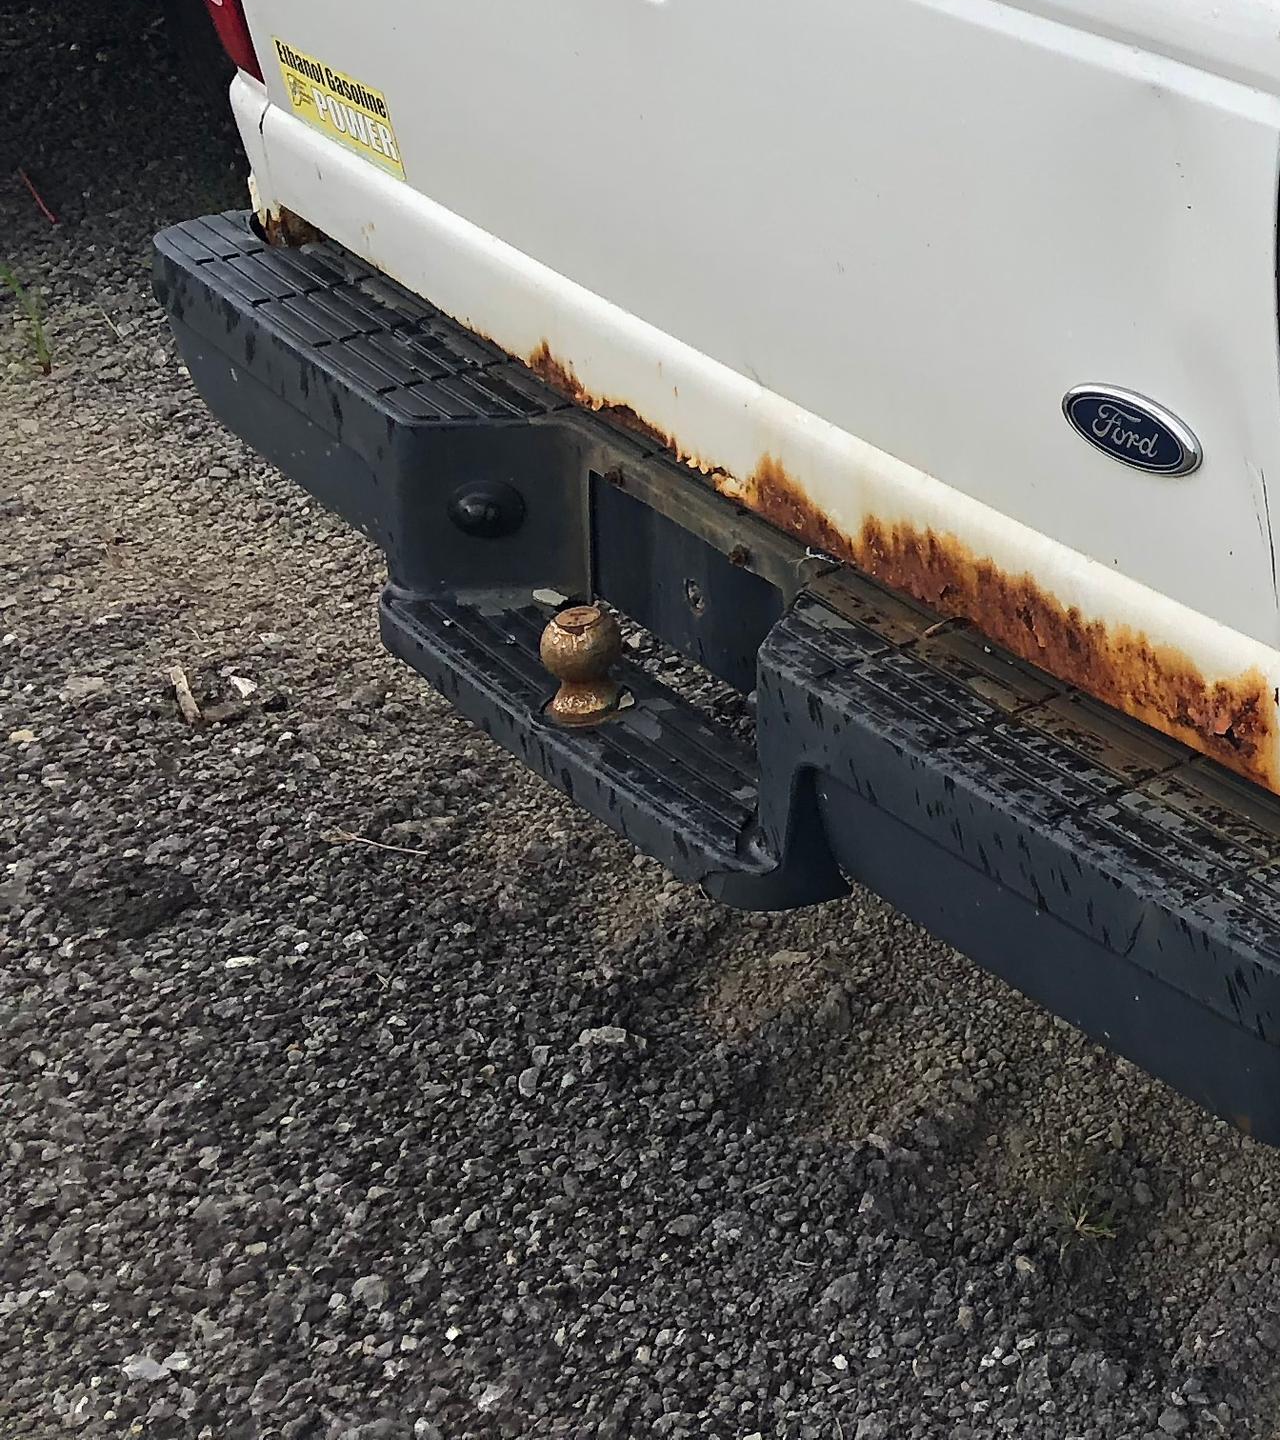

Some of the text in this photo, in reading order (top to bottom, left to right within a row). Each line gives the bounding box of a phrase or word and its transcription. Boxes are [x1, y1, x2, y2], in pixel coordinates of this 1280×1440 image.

[274, 39, 387, 119] Ethanol Gasoline
[311, 85, 400, 163] POWER
[1092, 403, 1158, 458] Ford
